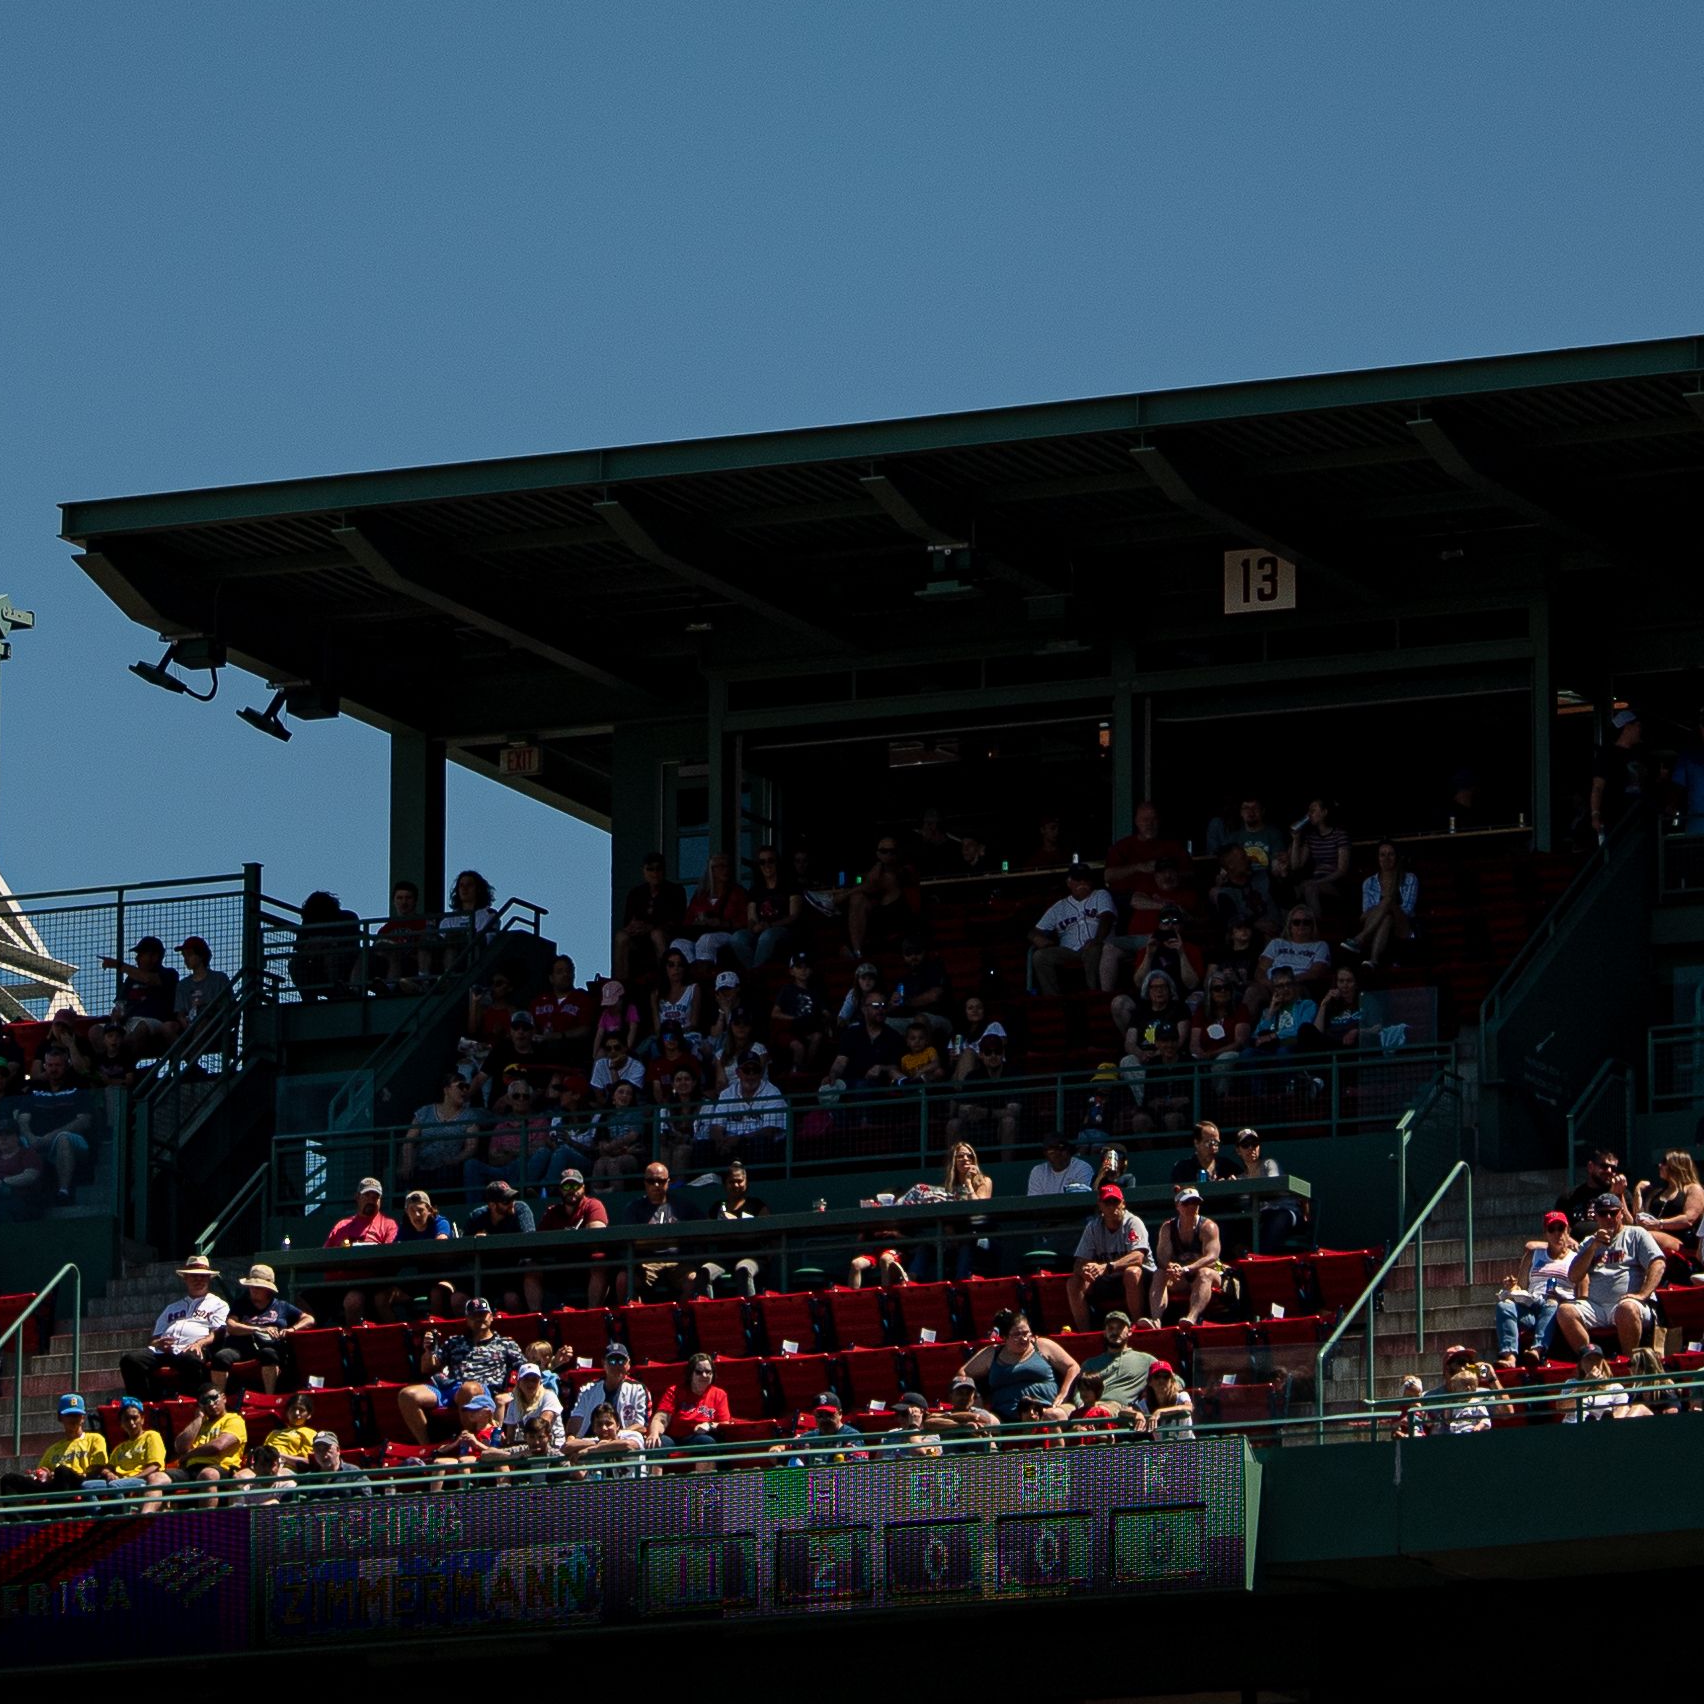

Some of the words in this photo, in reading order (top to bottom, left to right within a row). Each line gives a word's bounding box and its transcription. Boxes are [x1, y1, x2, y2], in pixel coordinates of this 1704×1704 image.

[1241, 557, 1278, 603] 13
[507, 748, 533, 772] EXIT
[278, 1503, 463, 1553] PITCHING
[282, 1563, 587, 1624] ZIMMERMANN
